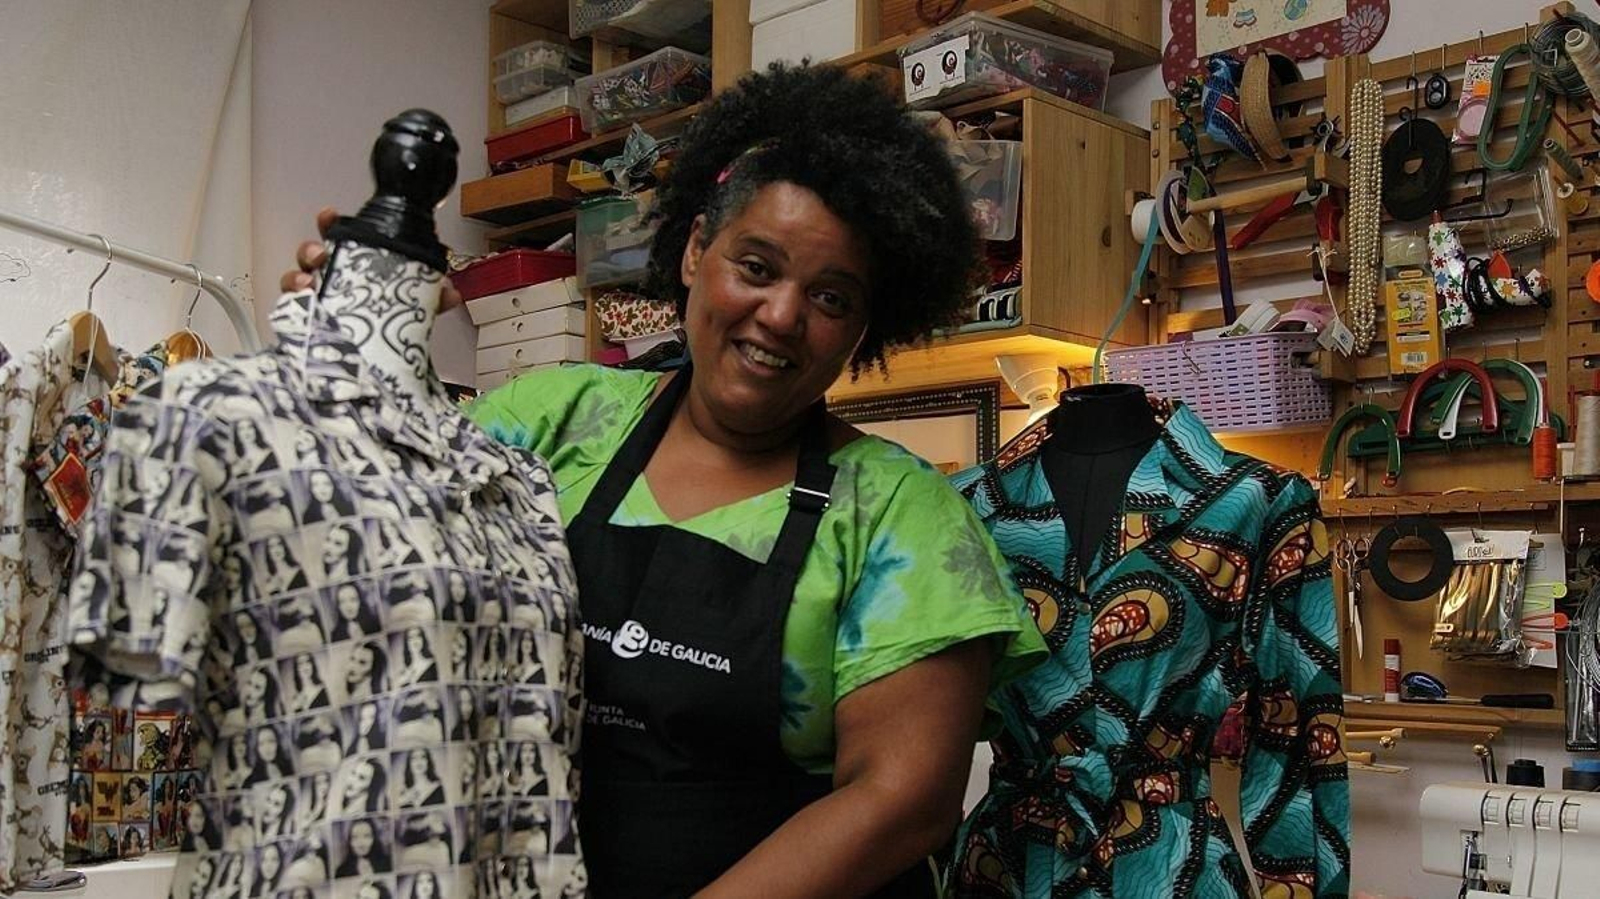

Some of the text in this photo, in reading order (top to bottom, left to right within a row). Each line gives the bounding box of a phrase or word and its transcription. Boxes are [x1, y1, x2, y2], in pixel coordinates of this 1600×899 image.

[649, 638, 672, 657] DE
[672, 644, 732, 674] GALICIA
[602, 715, 646, 731] GALICIA
